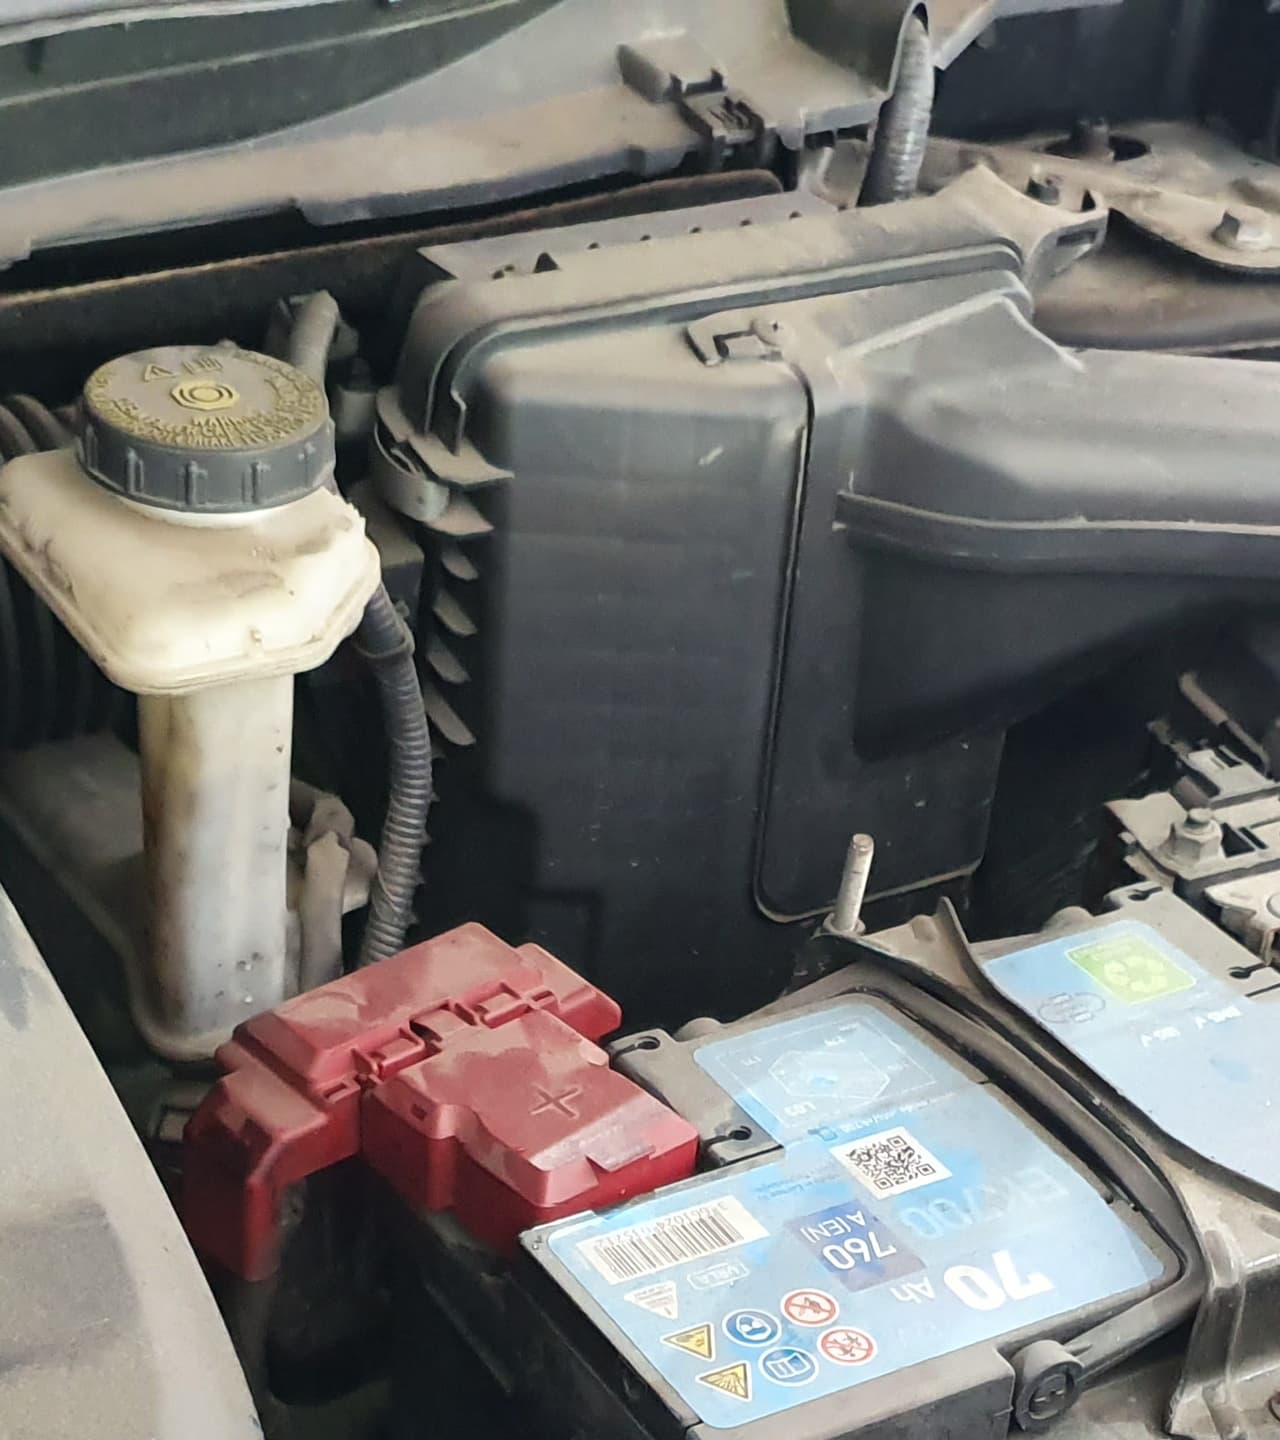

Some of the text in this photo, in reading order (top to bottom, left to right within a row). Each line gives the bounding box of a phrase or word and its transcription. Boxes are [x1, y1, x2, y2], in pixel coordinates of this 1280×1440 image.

[823, 1239, 897, 1273] 760
[890, 1250, 1057, 1311] 70 Ah
